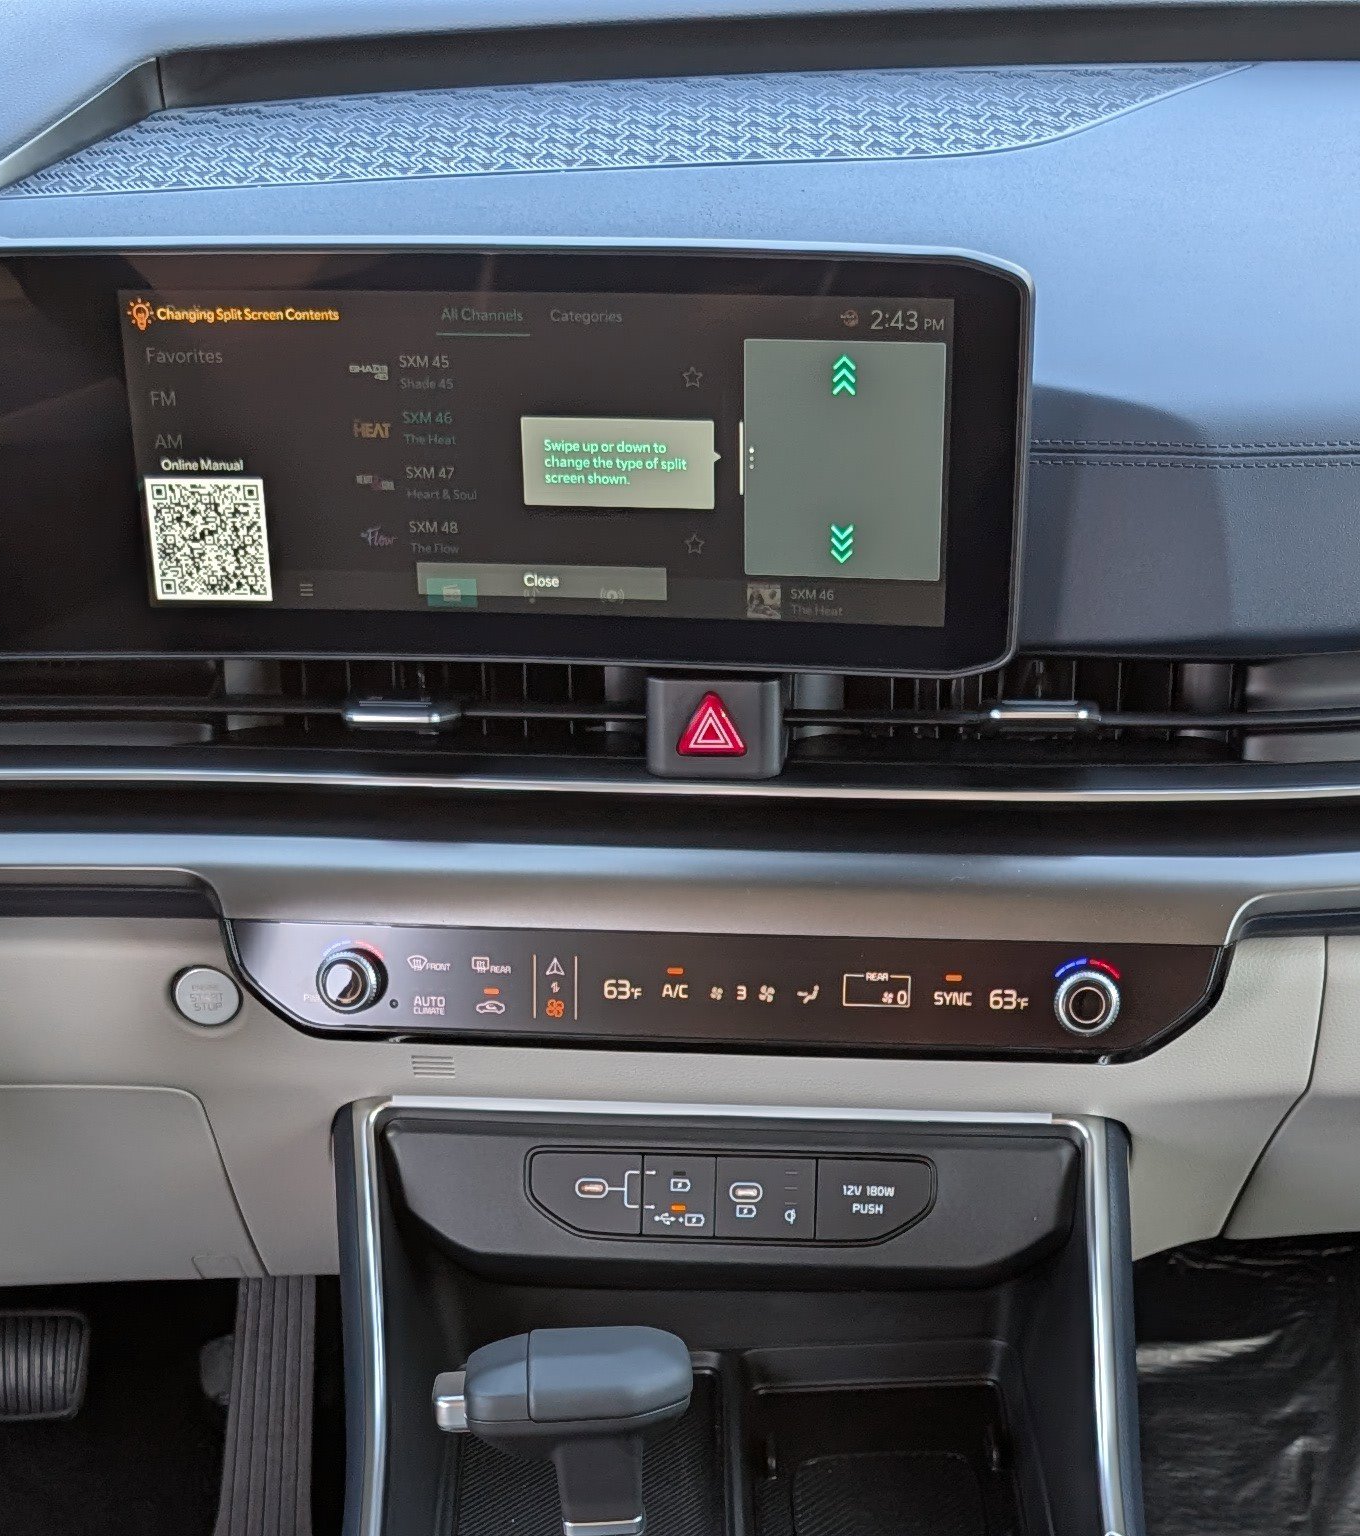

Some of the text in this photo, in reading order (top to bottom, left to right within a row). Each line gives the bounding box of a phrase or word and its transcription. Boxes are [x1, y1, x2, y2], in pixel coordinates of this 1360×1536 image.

[156, 308, 340, 323] Changing Split Screen Contents
[441, 308, 523, 322] All Channels
[550, 309, 623, 325] Categories
[870, 309, 944, 331] 2:43 PM
[145, 347, 223, 364] Favorites
[399, 355, 450, 369] SXM 45
[400, 377, 436, 389] Shade
[438, 378, 454, 390] 45
[150, 390, 176, 406] FM
[402, 411, 453, 424] SXM 46
[154, 434, 183, 449] AM
[403, 433, 457, 446] The Heat
[544, 439, 667, 454] Swipe up or down to
[160, 458, 244, 471] Online Manual
[544, 455, 687, 472] change the type of split
[406, 466, 455, 480] SXM 47
[544, 473, 630, 485] screen shown.
[406, 490, 477, 501] Heart & Soul
[409, 521, 459, 534] SXM 48
[410, 543, 460, 554] The Flow
[523, 572, 560, 588] Close
[790, 588, 834, 600] SXM 46
[425, 962, 451, 971] FRONT
[490, 965, 512, 974] REAR
[865, 972, 889, 982] REAR
[661, 983, 689, 999] A/C
[736, 985, 747, 1001] 3
[896, 990, 908, 1005] 0
[413, 995, 446, 1007] AUTO
[933, 991, 972, 1007] SYNC
[194, 1002, 223, 1012] STOP
[413, 1007, 445, 1016] CLIMATE
[843, 1184, 895, 1197] 12V 180W
[852, 1202, 884, 1215] PUSH
